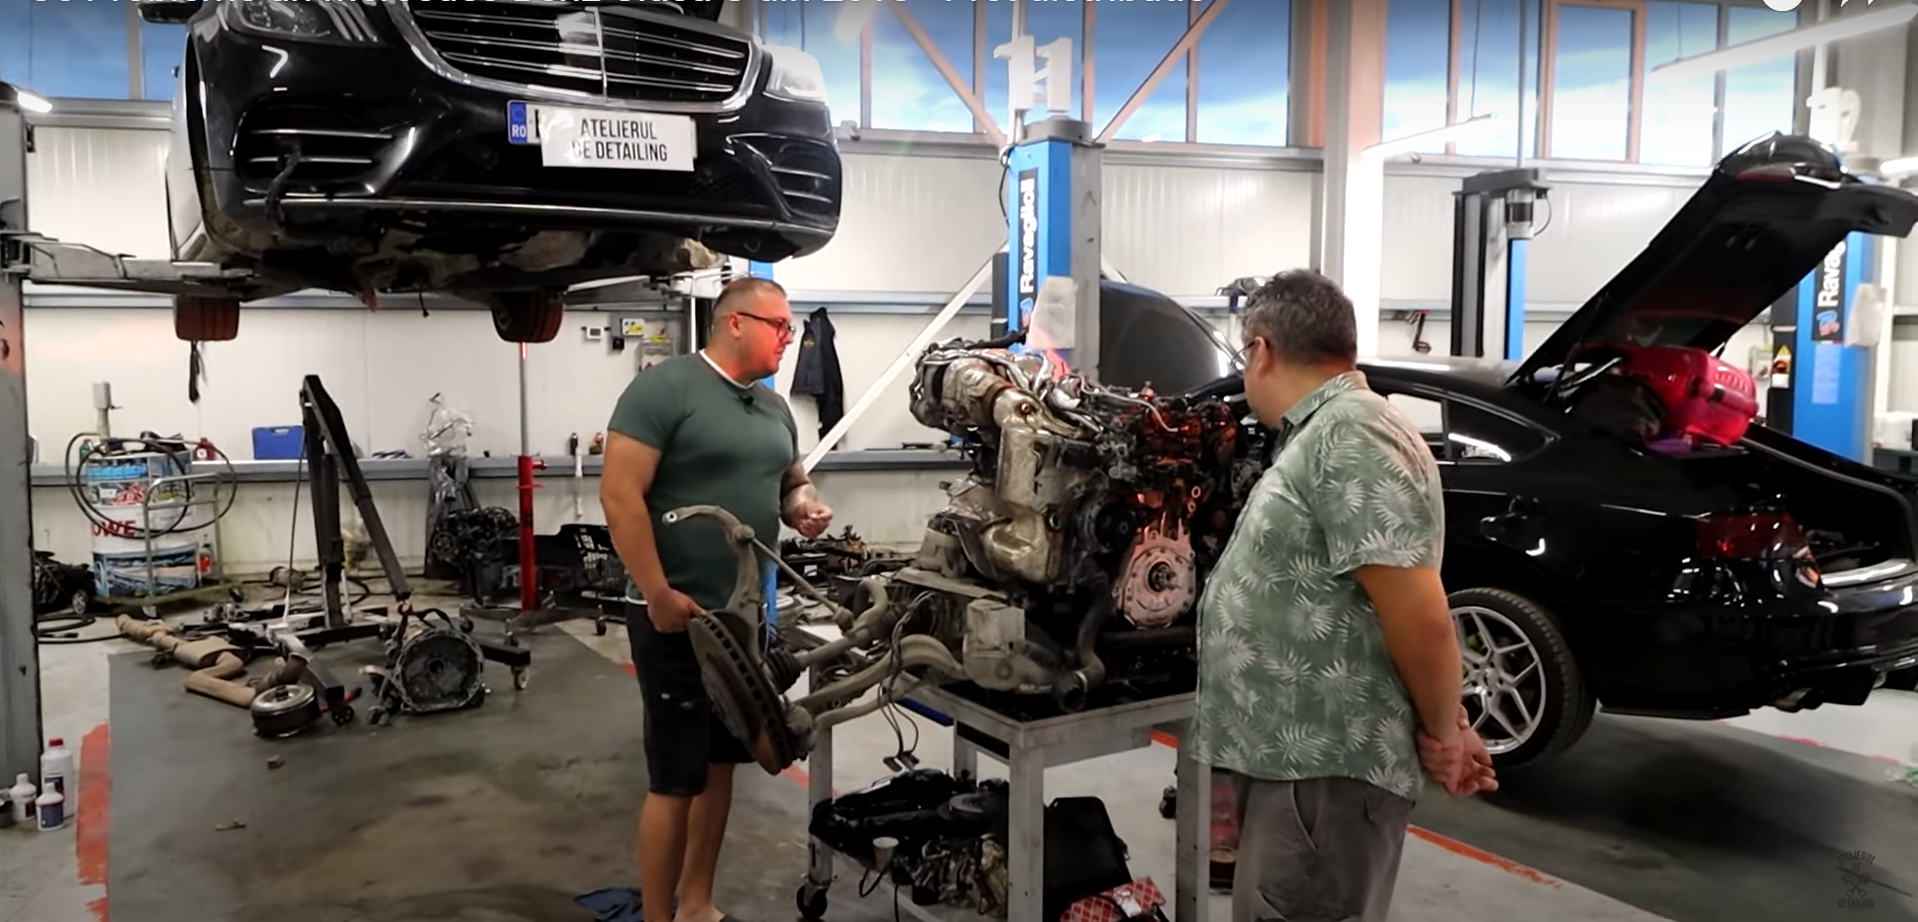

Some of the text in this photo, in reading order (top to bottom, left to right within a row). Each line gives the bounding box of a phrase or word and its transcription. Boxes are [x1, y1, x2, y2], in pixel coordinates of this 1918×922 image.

[993, 35, 1073, 113] 11
[511, 124, 527, 138] RO
[580, 118, 657, 140] ATELIERUL
[572, 141, 668, 162] DE DETAILING
[1020, 178, 1038, 293] Ravaglioli
